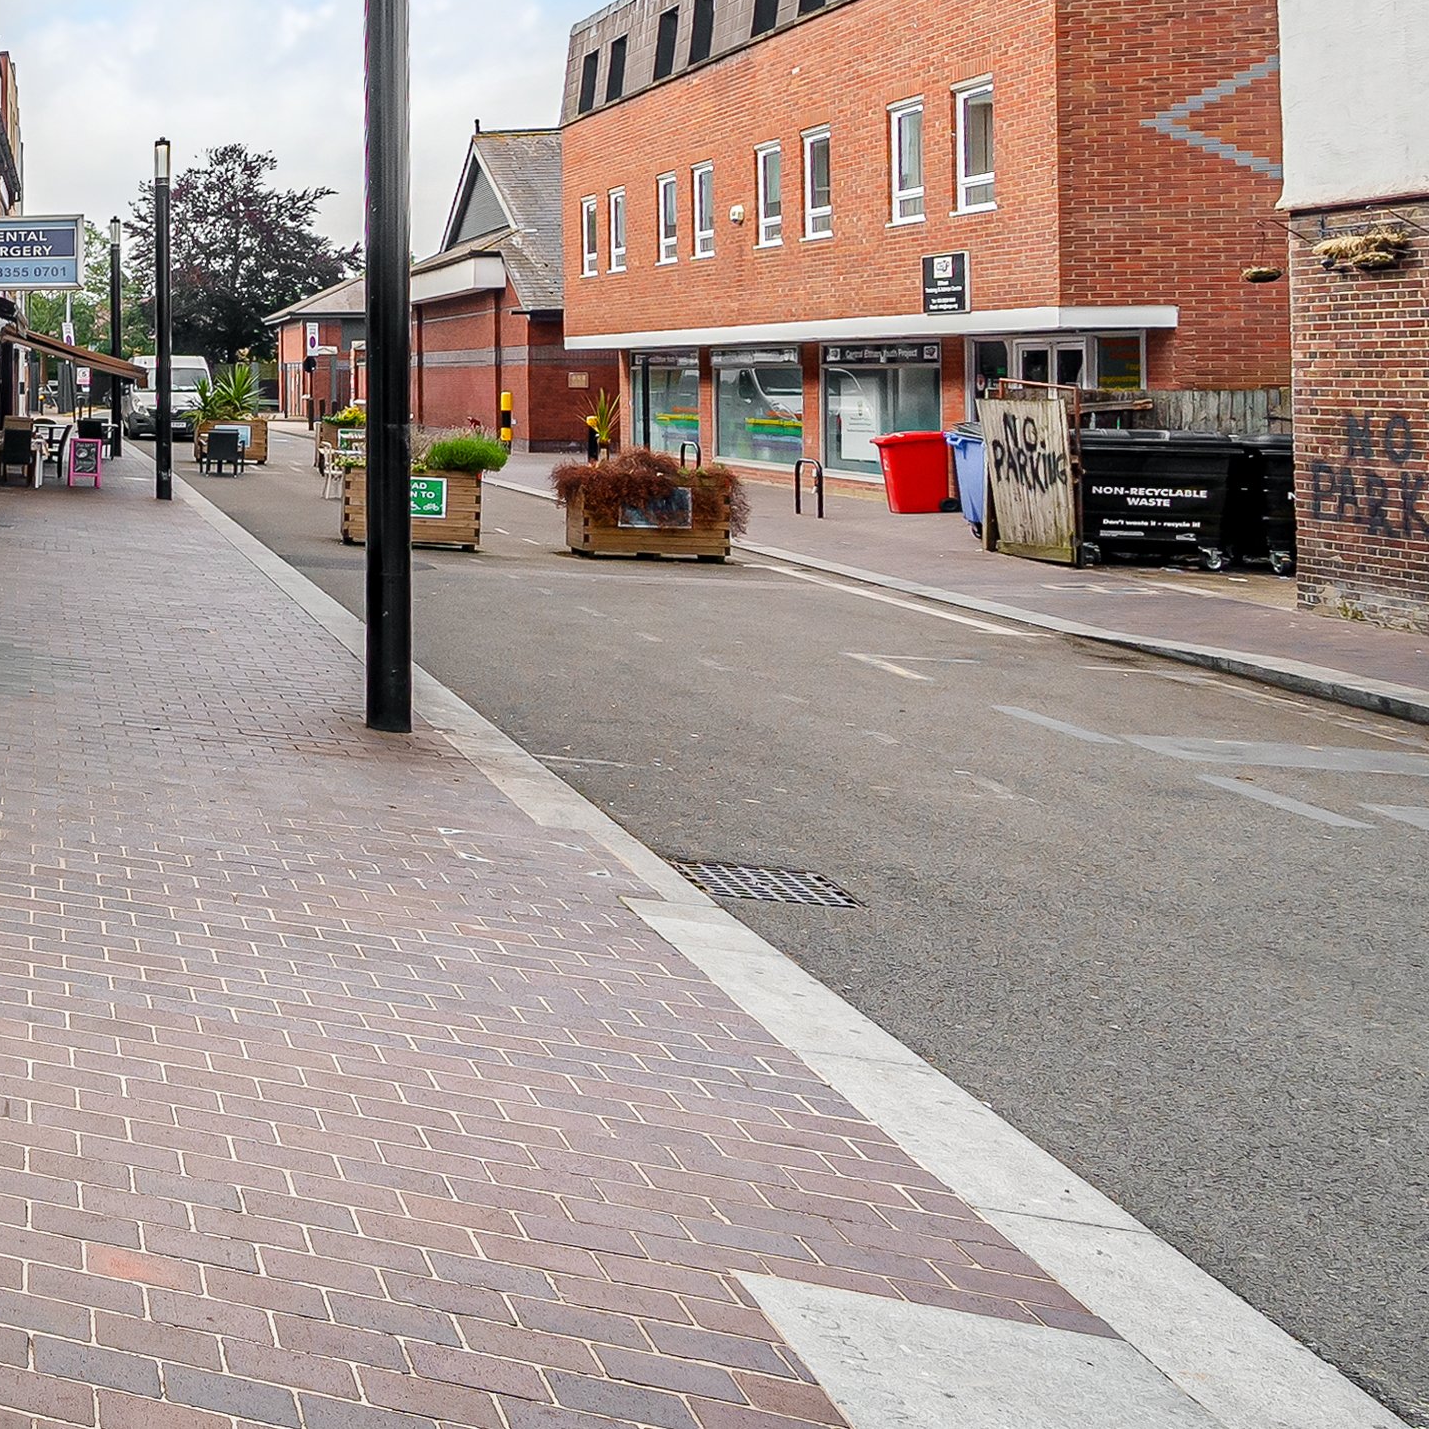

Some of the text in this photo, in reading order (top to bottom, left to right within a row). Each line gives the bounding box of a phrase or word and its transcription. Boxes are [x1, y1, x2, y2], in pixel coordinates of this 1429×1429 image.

[33, 266, 67, 277] 0701
[1346, 414, 1412, 463] NO
[992, 440, 1068, 494] PARKING
[410, 482, 428, 490] AD
[421, 491, 436, 499] TO
[1092, 485, 1208, 499] NON-RECYCLABLE
[1126, 498, 1171, 508] WASTE
